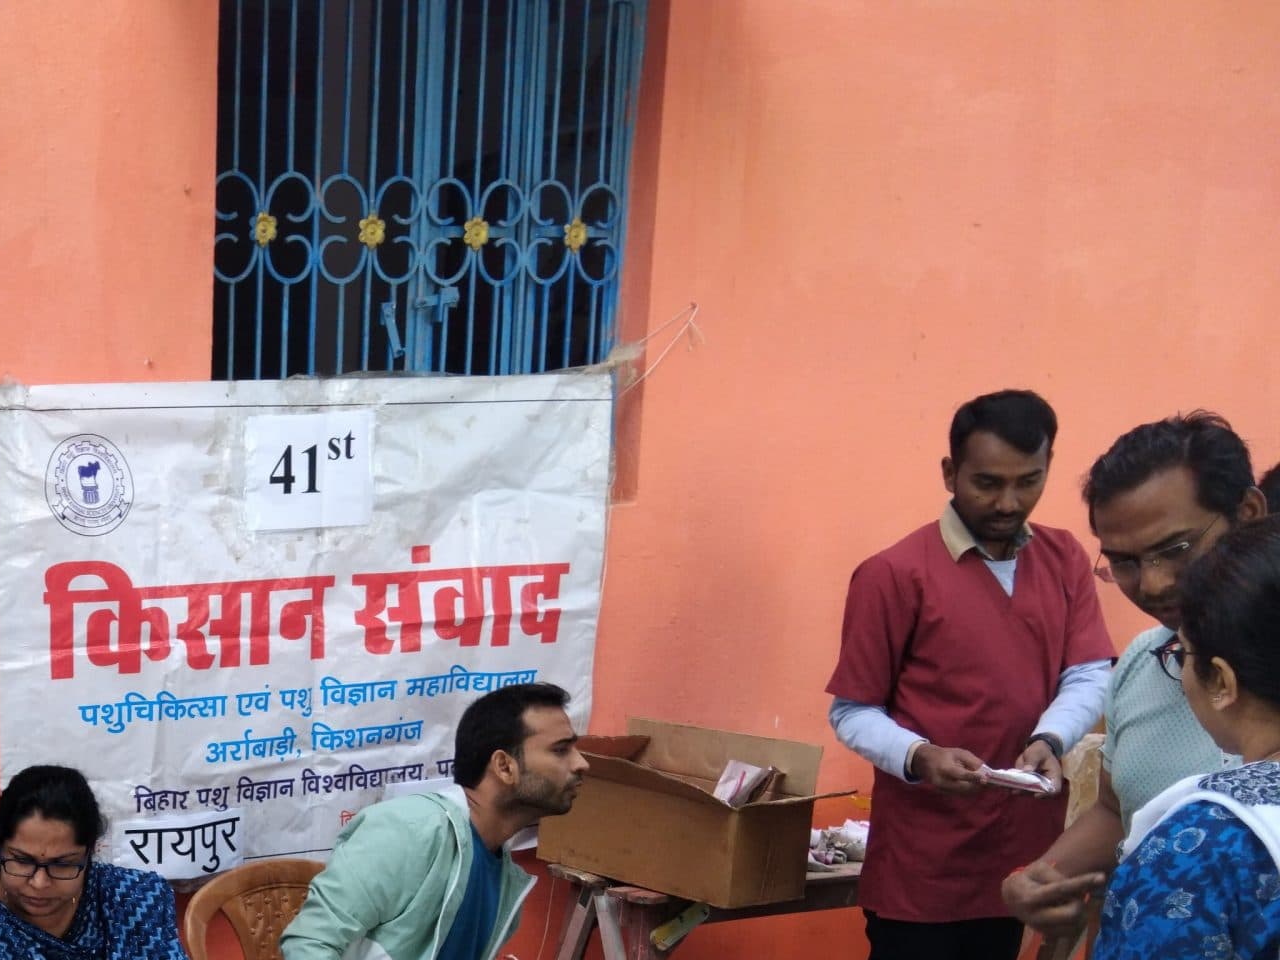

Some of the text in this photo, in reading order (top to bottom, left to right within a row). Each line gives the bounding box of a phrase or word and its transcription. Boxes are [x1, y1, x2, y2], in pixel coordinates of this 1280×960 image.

[43, 545, 569, 680] किसान संवाद
[78, 690, 228, 733] पशुचिकित्सा
[236, 683, 271, 717] एवं
[280, 687, 313, 717] पशु
[320, 676, 398, 706] विज्ञान
[311, 717, 424, 752] किशनगंज
[134, 785, 190, 813] बिहार
[196, 785, 230, 813] पशु
[237, 776, 296, 803] विज्ञान
[125, 817, 240, 873] रायपुर
